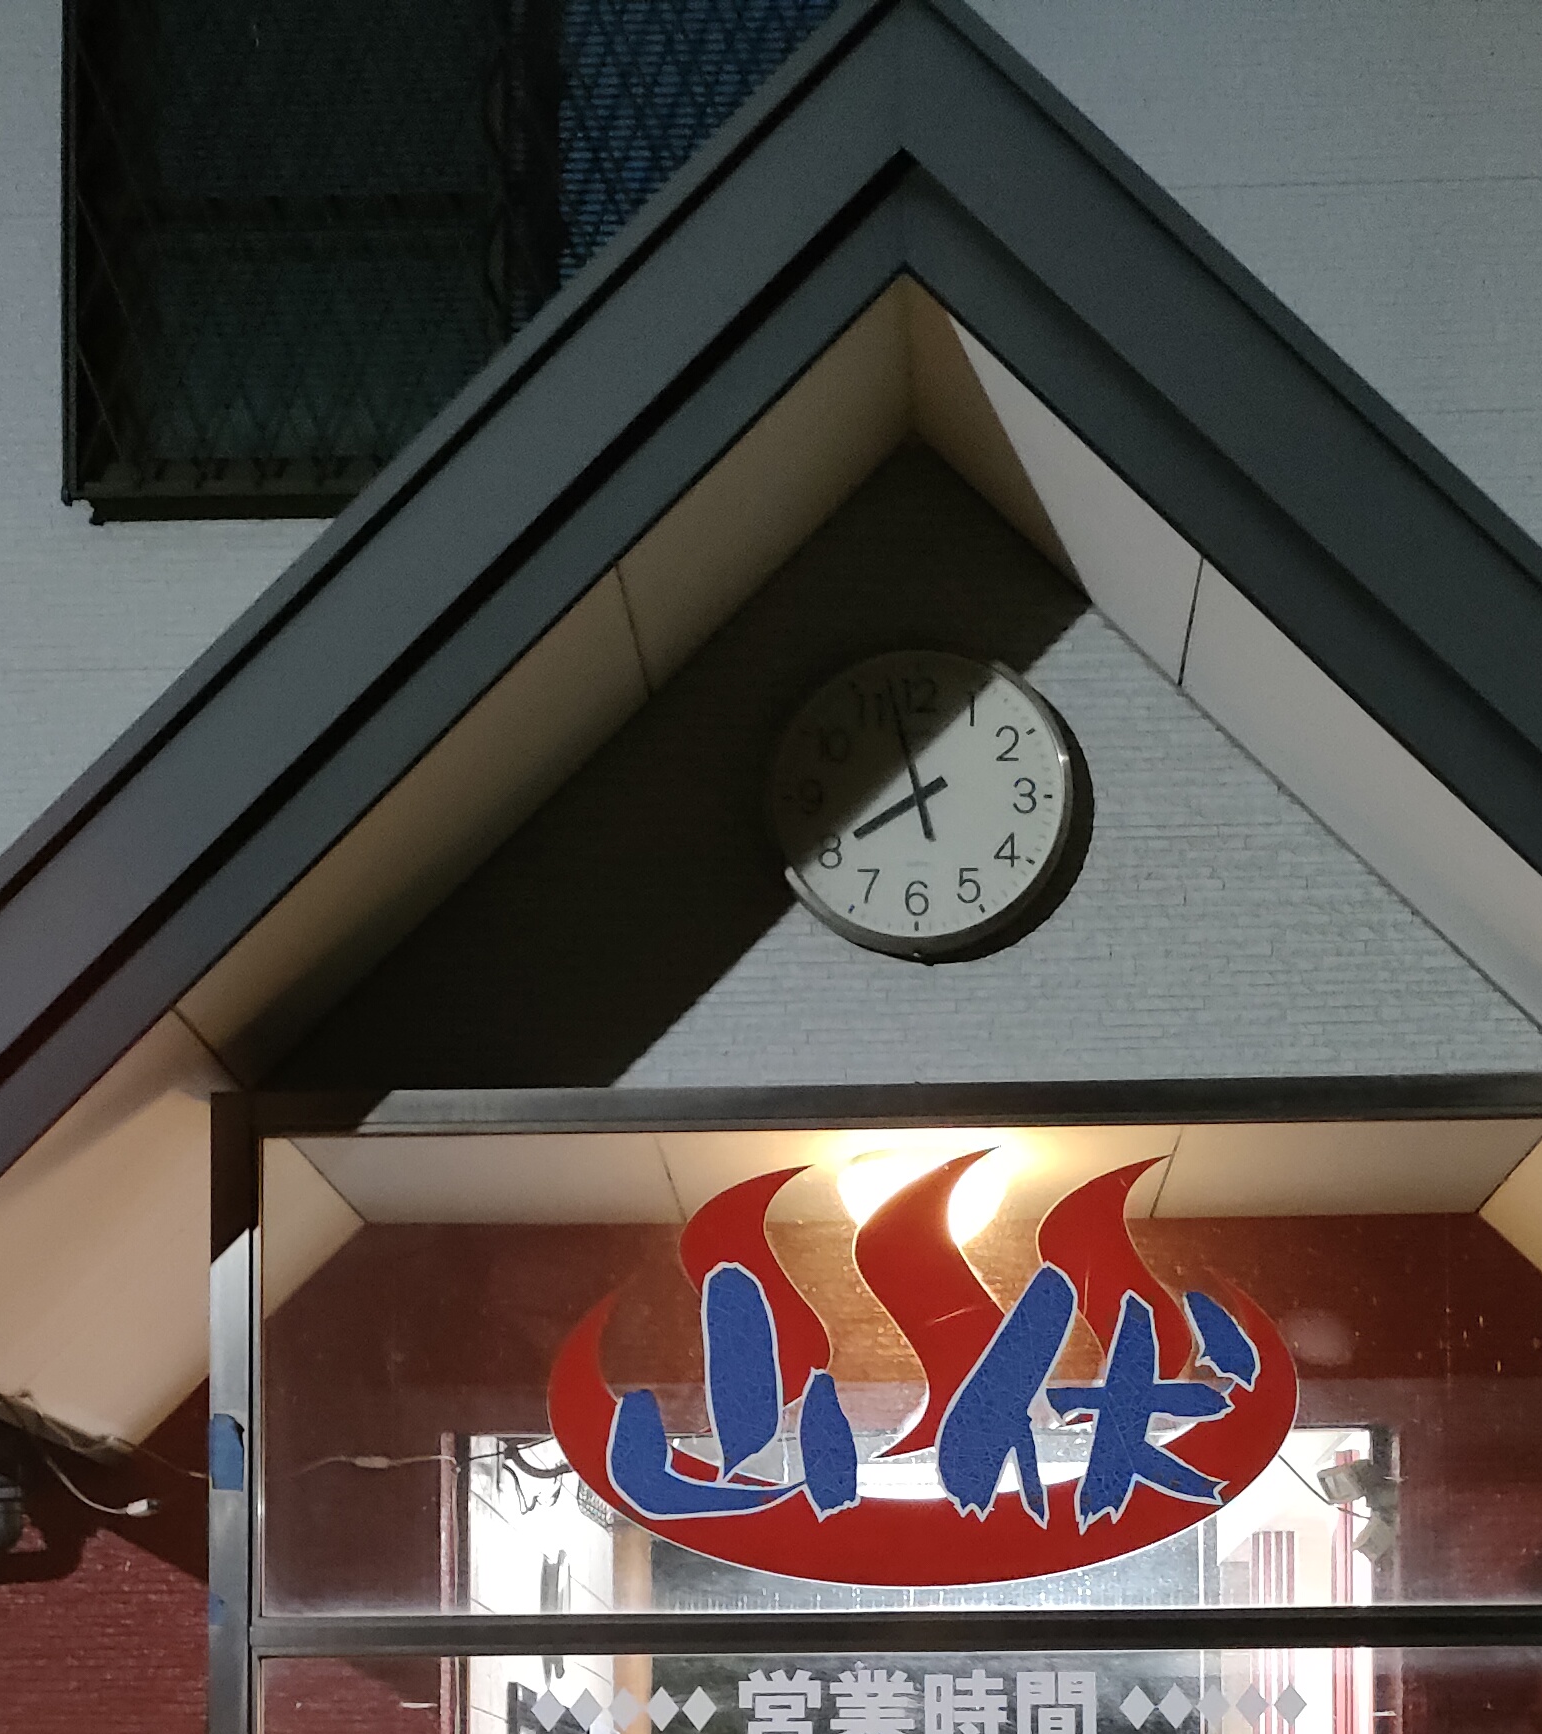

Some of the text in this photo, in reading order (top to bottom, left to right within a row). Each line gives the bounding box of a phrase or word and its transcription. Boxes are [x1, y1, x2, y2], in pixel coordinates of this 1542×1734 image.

[967, 694, 976, 727] 1
[995, 724, 1020, 762] 2
[1012, 777, 1037, 814] 3
[817, 833, 843, 870] 8
[993, 832, 1021, 868] 4
[856, 868, 880, 904] 7
[904, 880, 929, 917] 6
[956, 867, 981, 904] 5
[606, 1261, 1260, 1535] 山伏
